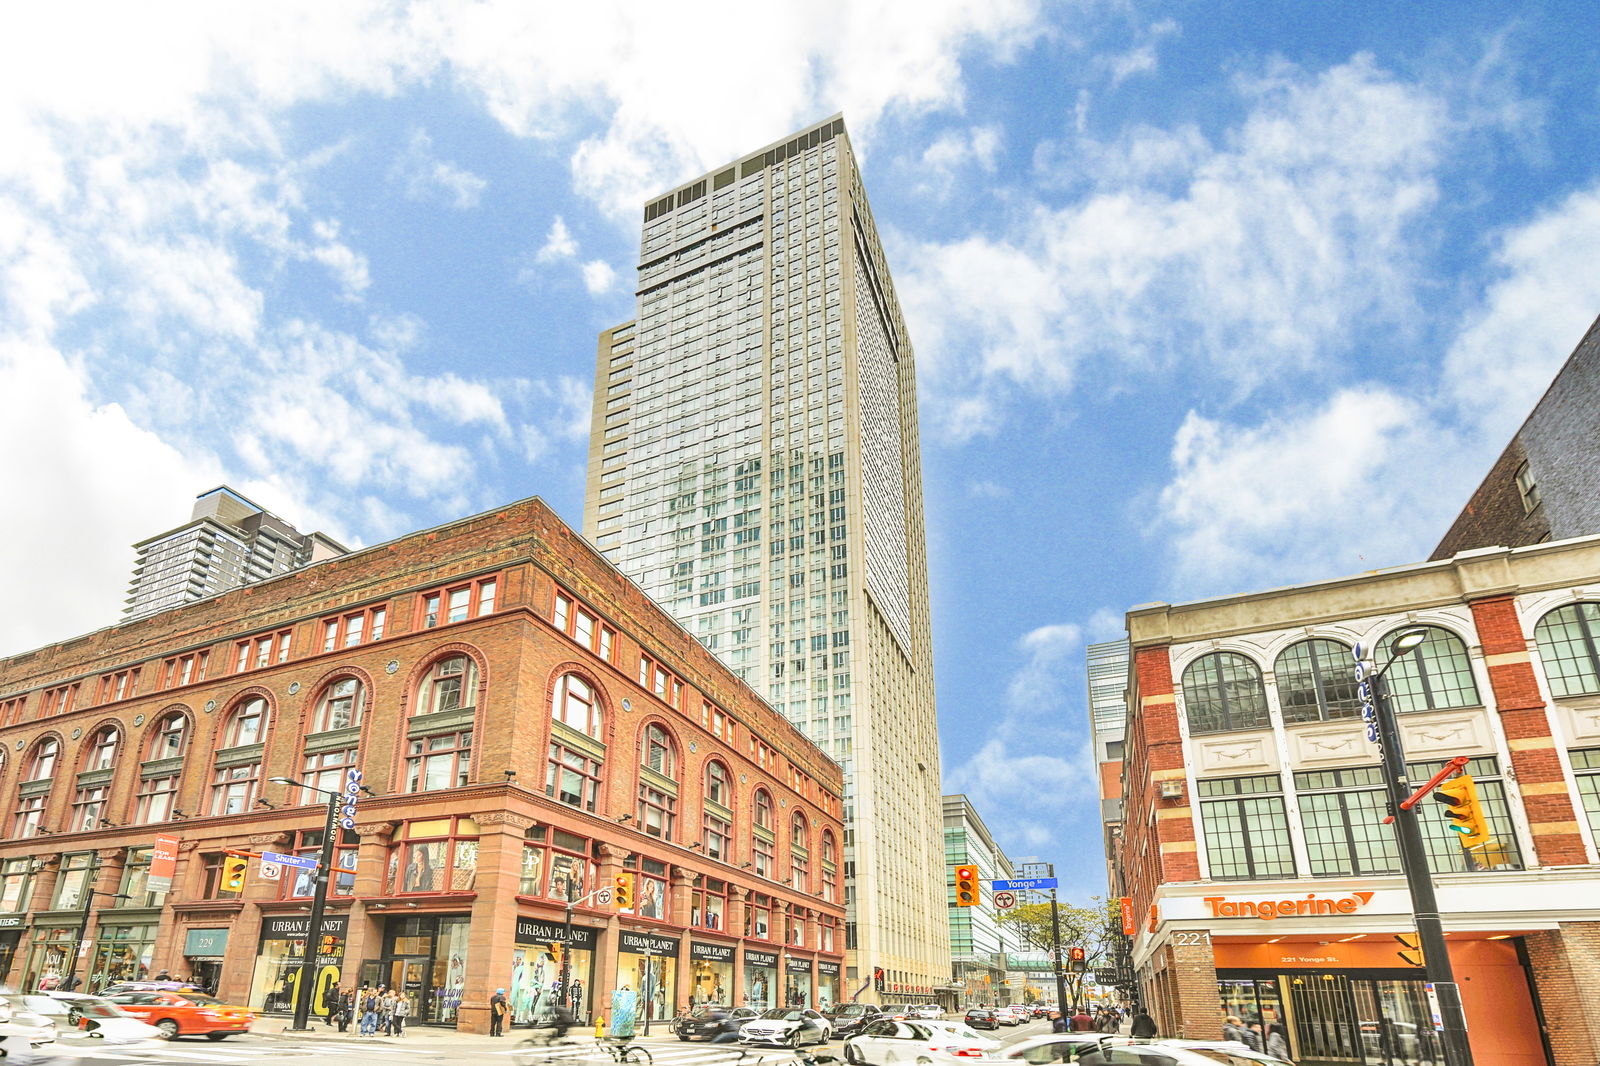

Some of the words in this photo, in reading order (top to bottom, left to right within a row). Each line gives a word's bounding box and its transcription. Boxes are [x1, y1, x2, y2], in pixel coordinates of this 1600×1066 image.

[274, 854, 300, 865] Shuter
[1007, 880, 1035, 890] Yonge
[1203, 893, 1358, 920] Tangerine
[272, 921, 303, 932] URBAN
[518, 922, 552, 938] URBAN
[623, 935, 649, 948] URBAN
[649, 939, 674, 951] PLANET
[1176, 932, 1212, 946] 221
[693, 944, 712, 955] URBAN
[712, 947, 731, 957] PLANET
[745, 952, 760, 962] URBAN
[760, 954, 775, 963] PLANET
